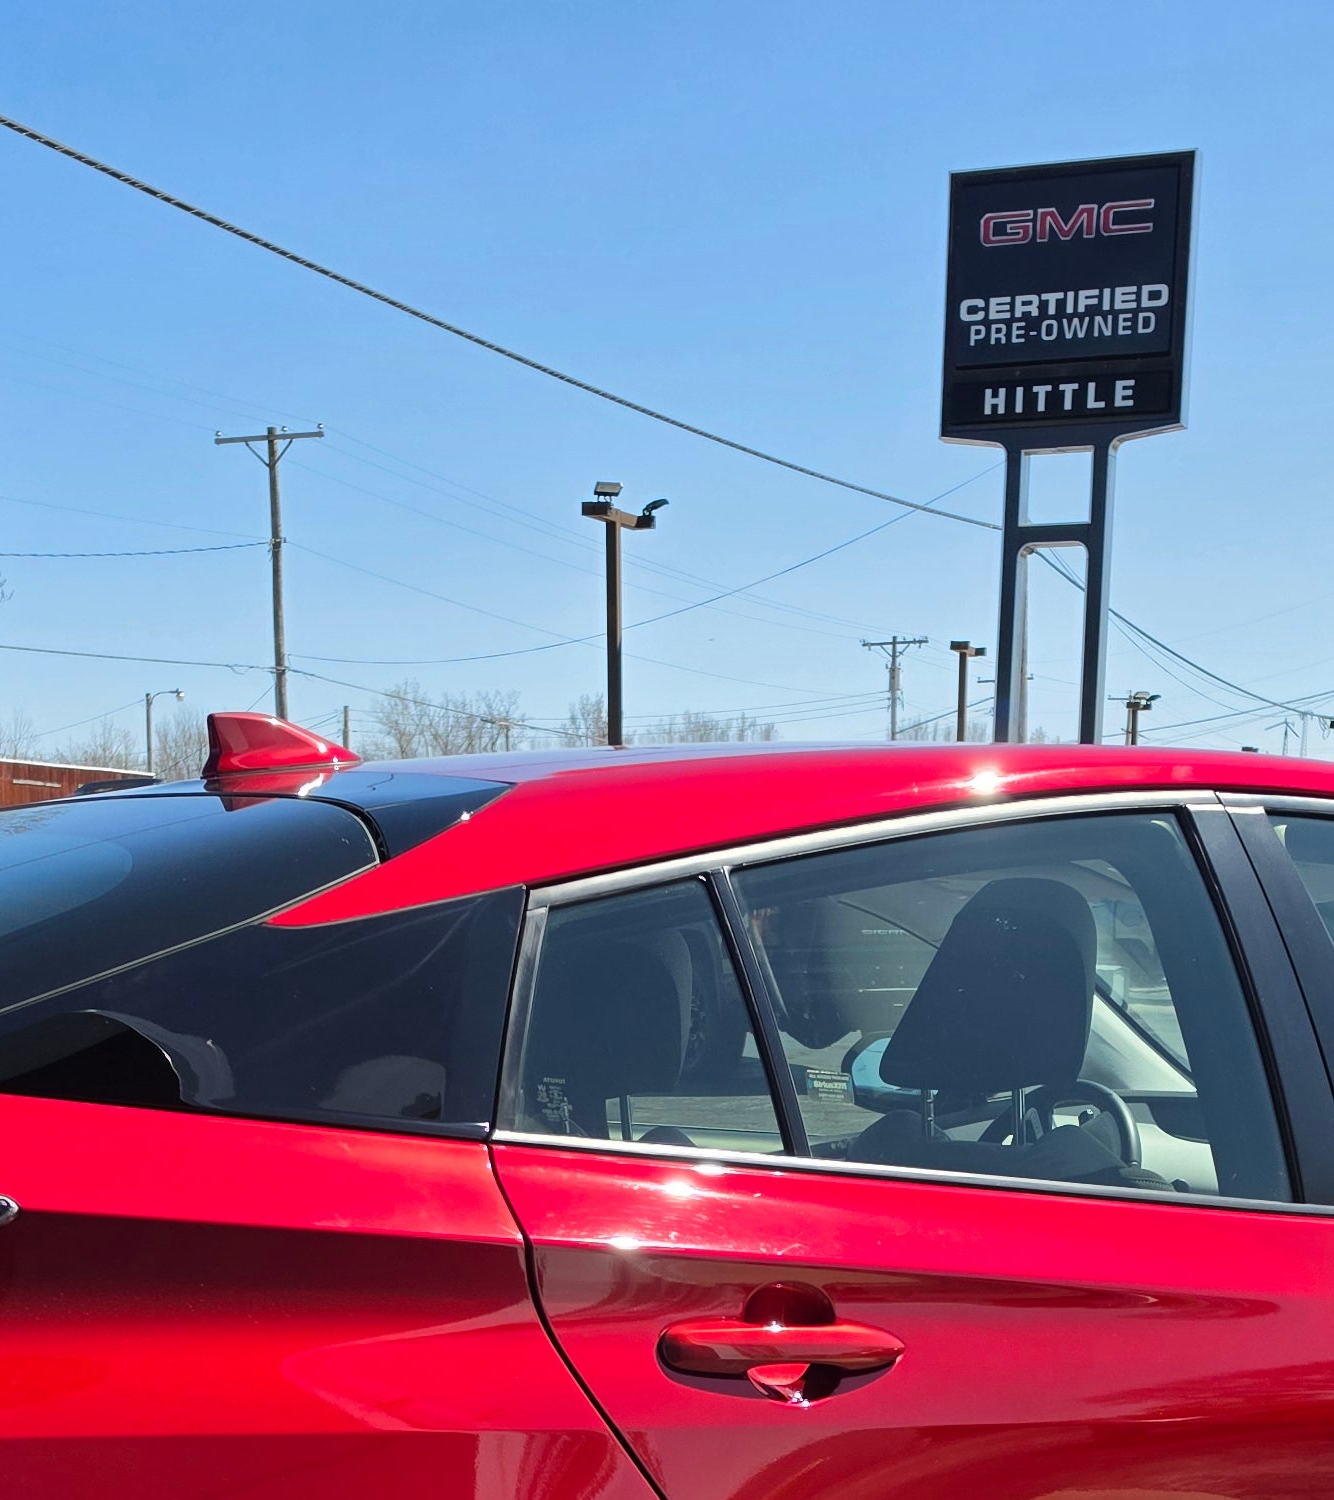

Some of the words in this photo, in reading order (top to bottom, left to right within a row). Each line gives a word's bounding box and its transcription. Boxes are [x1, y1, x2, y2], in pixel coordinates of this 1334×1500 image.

[979, 198, 1155, 247] GMC
[959, 284, 1170, 322] CERTIFIED
[969, 312, 1156, 346] PRE-OWNED
[983, 379, 1136, 415] HITTLE
